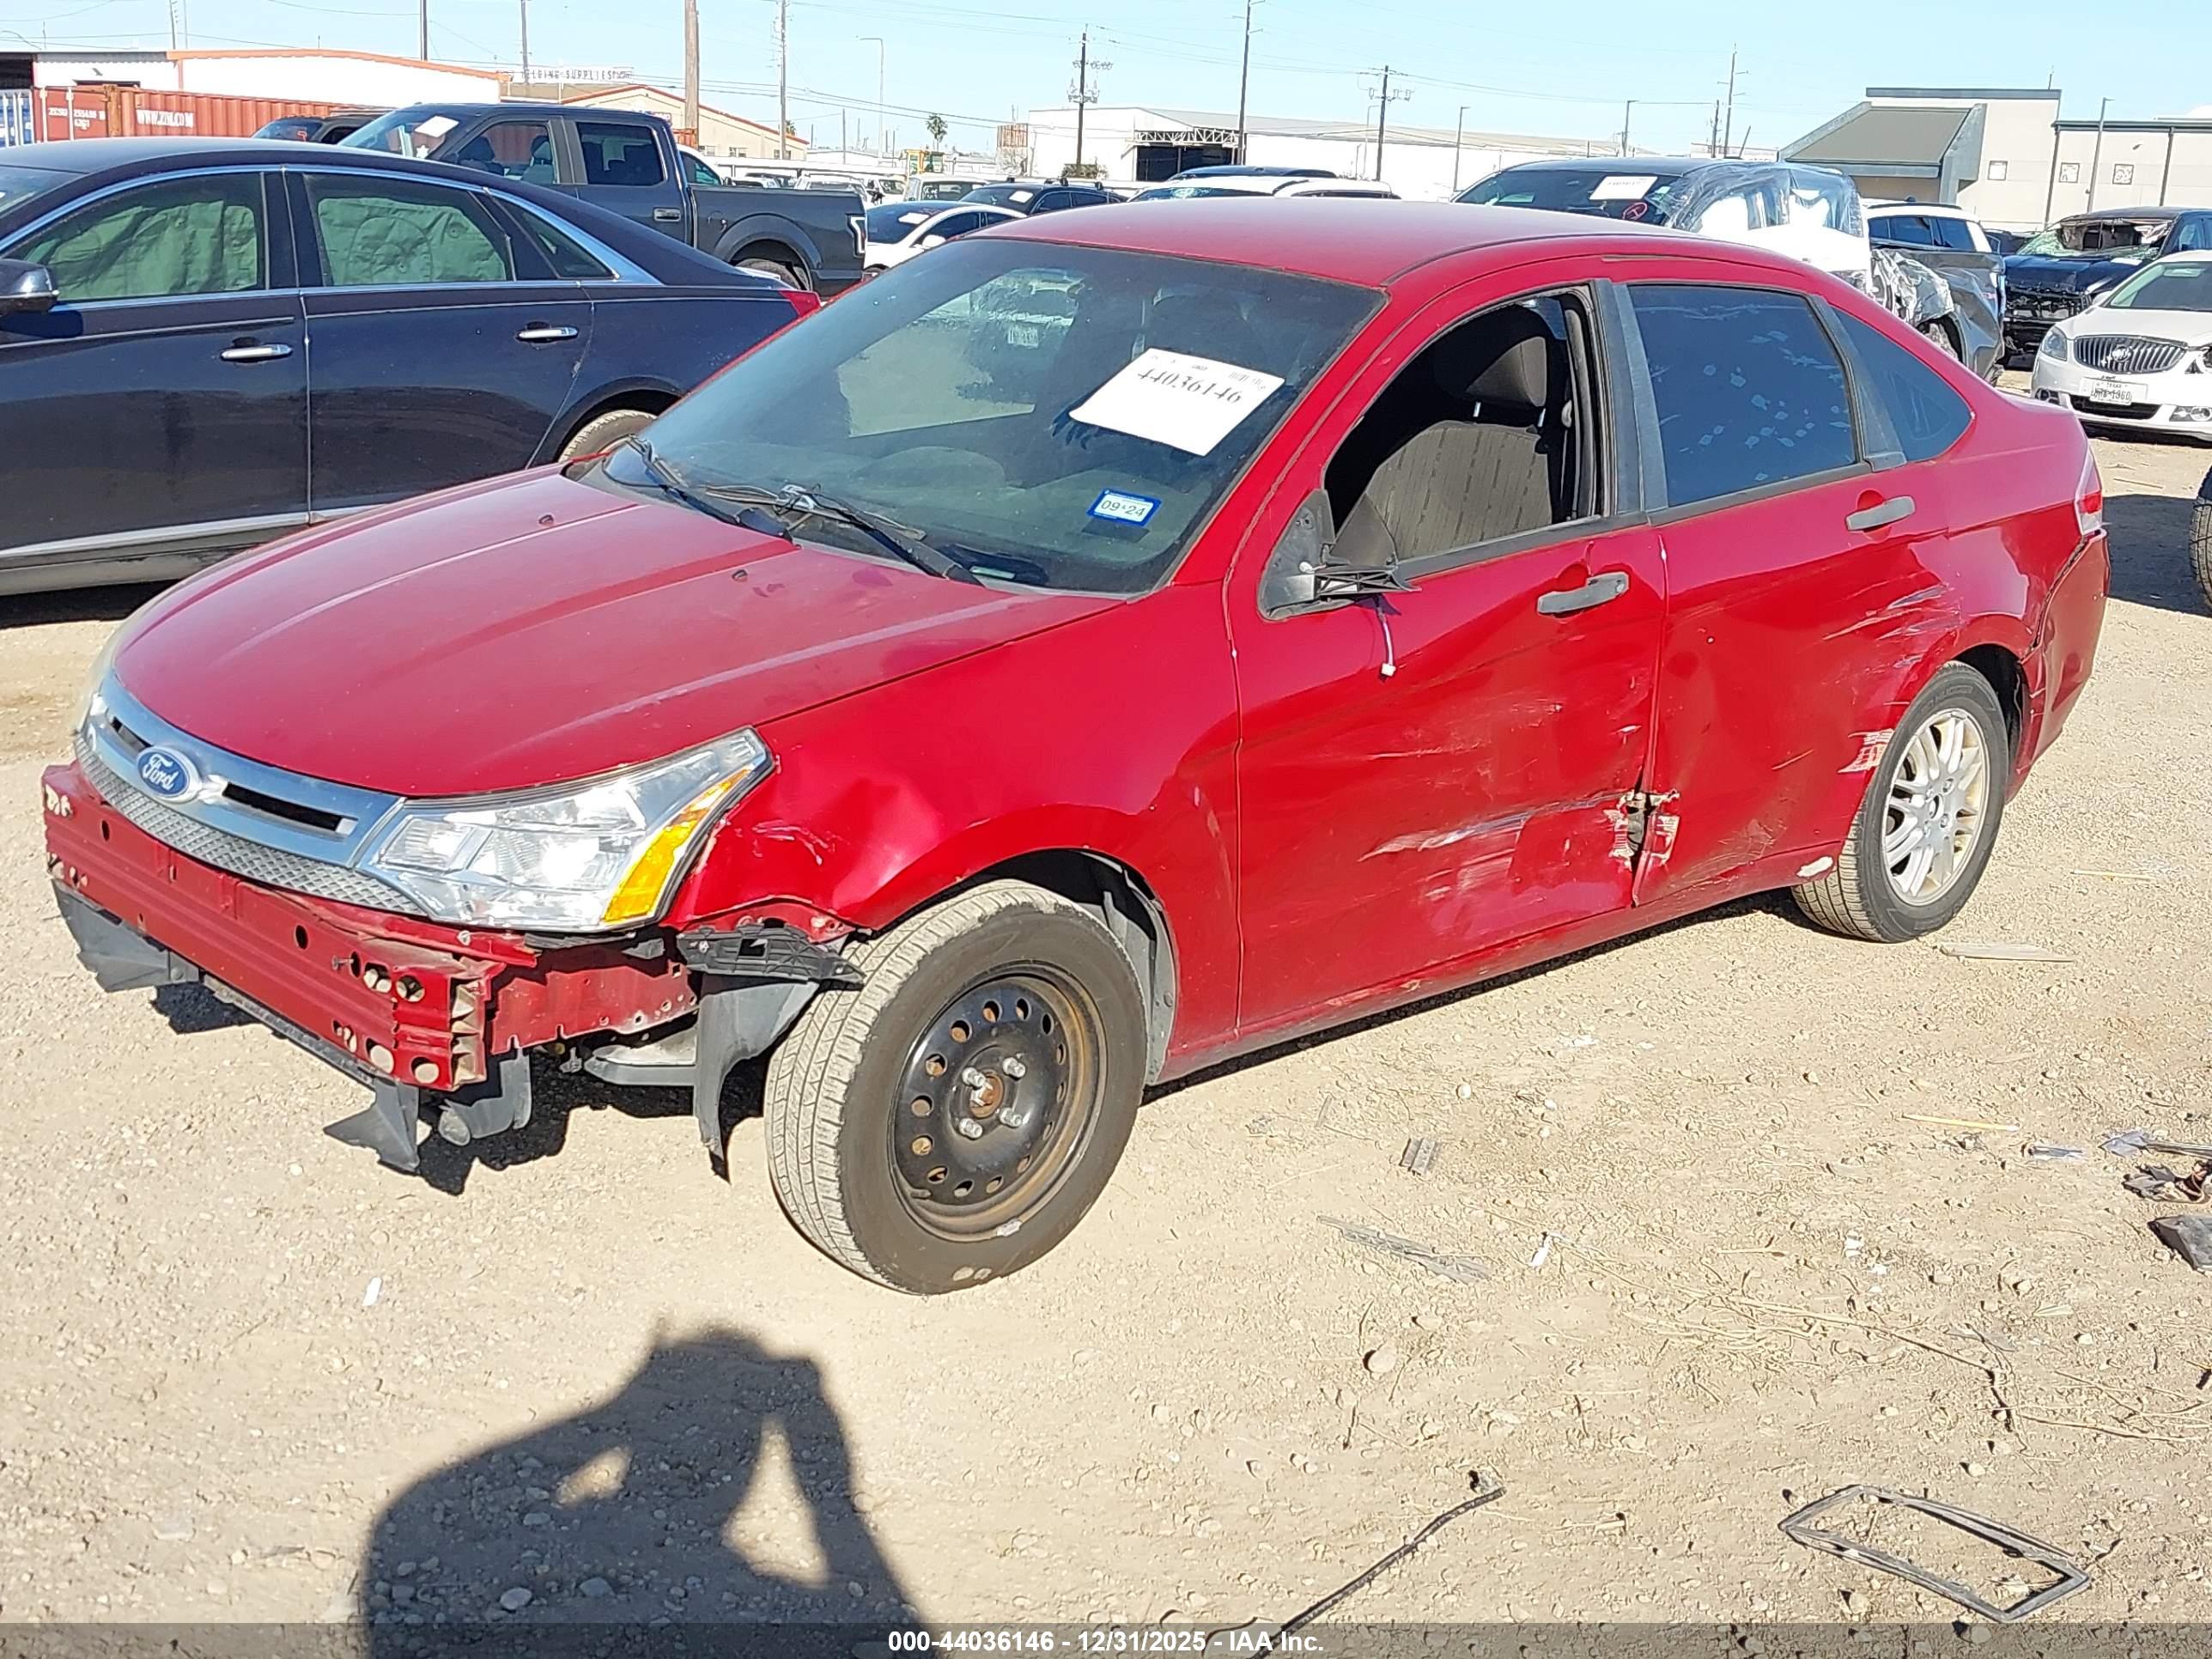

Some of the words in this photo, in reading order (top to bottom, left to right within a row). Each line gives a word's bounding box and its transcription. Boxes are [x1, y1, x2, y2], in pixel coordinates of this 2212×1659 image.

[565, 69, 611, 81] SUPPLIES
[1138, 368, 1242, 403] 44036146
[142, 753, 179, 791] Ford
